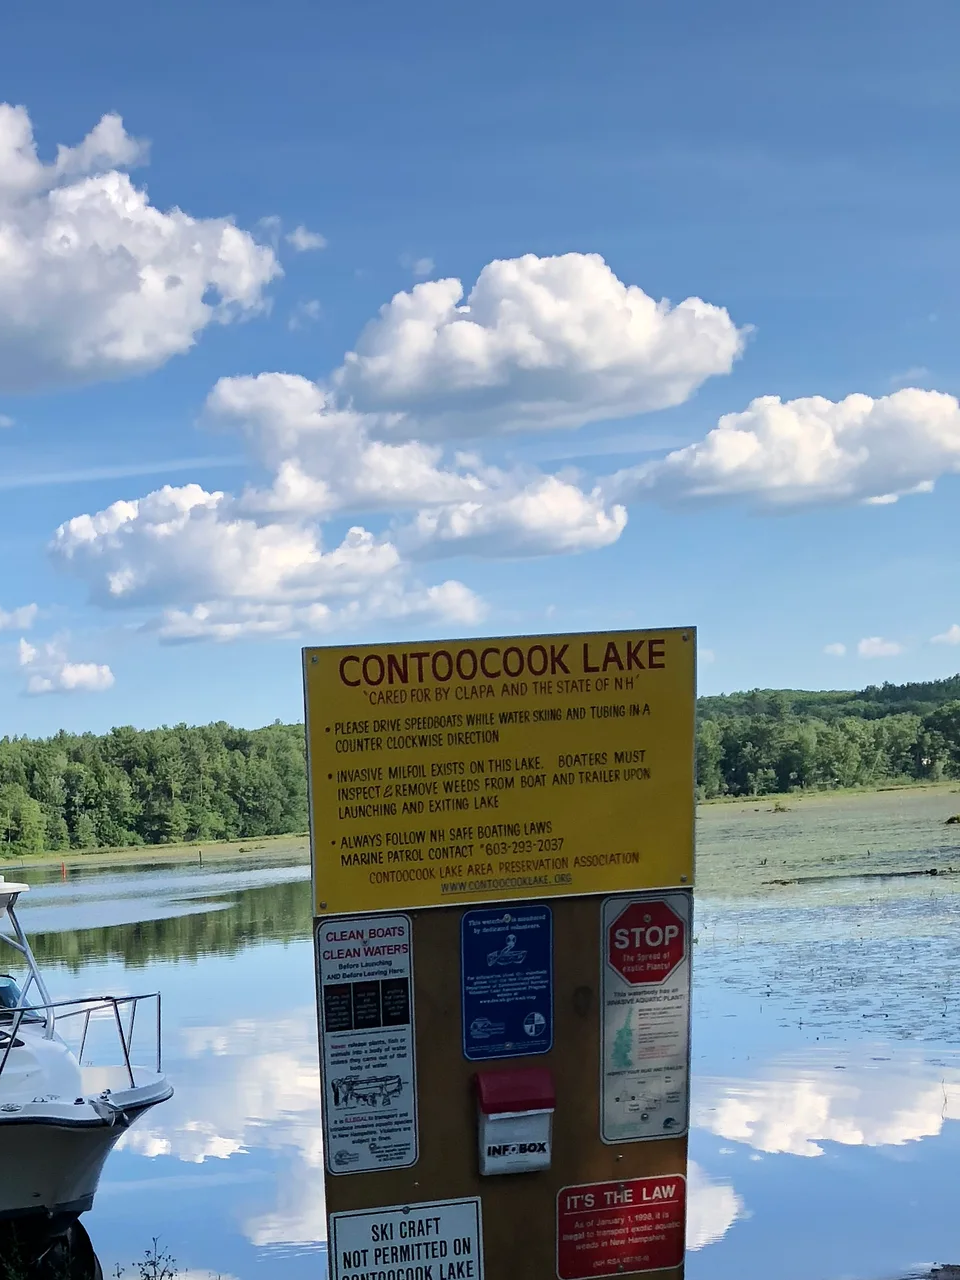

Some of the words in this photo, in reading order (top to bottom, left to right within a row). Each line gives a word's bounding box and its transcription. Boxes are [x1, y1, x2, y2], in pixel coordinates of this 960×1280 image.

[339, 644, 571, 687] CONTOOCOOK
[583, 639, 665, 673] LAKE
[411, 688, 431, 703] FOR
[436, 687, 450, 701] BY
[455, 684, 495, 700] CLAPA
[501, 682, 528, 697] AND
[533, 681, 552, 695] THE
[557, 679, 591, 693] STATE
[595, 677, 609, 692] OF
[335, 720, 369, 735] PLEASE
[374, 718, 401, 733] DRIVE
[405, 714, 463, 730] SPEEDBOATS
[466, 713, 494, 728] WHILE
[499, 710, 530, 724] WATER
[533, 708, 562, 722] SKIING
[566, 707, 586, 721] AND
[591, 705, 625, 719] TUBING
[629, 703, 640, 717] IN
[642, 703, 651, 716] A
[336, 737, 382, 753] COUNTER
[387, 733, 443, 750] CLOCKWISE
[448, 730, 499, 746] DIRECTION
[337, 768, 382, 783] INVASIVE
[389, 765, 426, 780] MILFOIL
[431, 762, 465, 777] EXISTS
[470, 760, 485, 774] ON
[488, 758, 512, 773] THIS
[515, 756, 544, 771] LAKE.
[558, 752, 608, 768] BOATERS
[614, 750, 646, 764] MUST
[338, 786, 381, 801] INSPECT
[383, 785, 393, 799] &
[395, 782, 438, 798] REMOVE
[443, 779, 480, 794] WEEDS
[485, 776, 514, 791] FROM
[521, 774, 547, 789] BOAT
[552, 772, 575, 786] AND
[578, 769, 620, 784] TRAILER
[624, 767, 651, 782] UPON
[338, 803, 397, 820] LAUNCHING
[402, 801, 424, 815] AND
[429, 798, 470, 814] EXITING
[474, 795, 499, 810] LAKE
[340, 833, 382, 849] ALWAYS
[386, 830, 425, 846] FOLLOW
[430, 829, 445, 843] NH
[450, 826, 473, 841] SAFE
[477, 823, 520, 839] BOATING
[524, 820, 552, 836] LAWS
[340, 851, 383, 866] MARINE
[388, 848, 424, 863] PATROL
[428, 844, 474, 860] CONTACT
[369, 867, 436, 884] CONTOOCOOK
[440, 864, 463, 880] LAKE
[467, 861, 493, 877] AREA
[499, 857, 569, 875] PRESERVATION
[574, 852, 640, 868] ASSOCIATION
[326, 930, 364, 942] CLEAN
[369, 926, 404, 939] BOATS
[614, 925, 679, 949] STOP
[323, 948, 360, 961] CLEAN
[364, 944, 408, 957] WATERS
[622, 954, 634, 962] The
[637, 953, 661, 962] Spread
[663, 951, 670, 959] of
[327, 973, 341, 981] AND
[343, 971, 362, 979] Before
[364, 969, 387, 978] Leaving
[389, 967, 405, 975] Here:
[339, 963, 359, 971] Before
[361, 960, 393, 969] Launching
[566, 1193, 595, 1210] IT'S
[604, 1188, 633, 1206] THE
[642, 1184, 676, 1201] LAW
[372, 1223, 393, 1242] SKI
[400, 1217, 441, 1239] CRAFT
[562, 1230, 585, 1241] illegal
[587, 1230, 595, 1238] to
[596, 1225, 629, 1237] transport
[631, 1223, 653, 1233] exotic
[654, 1220, 680, 1231] aquatic
[574, 1220, 584, 1229] As
[586, 1219, 595, 1227] of
[596, 1215, 625, 1226] January
[635, 1213, 654, 1222] 1998,
[655, 1211, 661, 1219] it
[343, 1249, 369, 1269] NOT
[374, 1240, 447, 1265] PERMITTED
[453, 1237, 471, 1256] ON
[440, 1260, 474, 1280] LAKE
